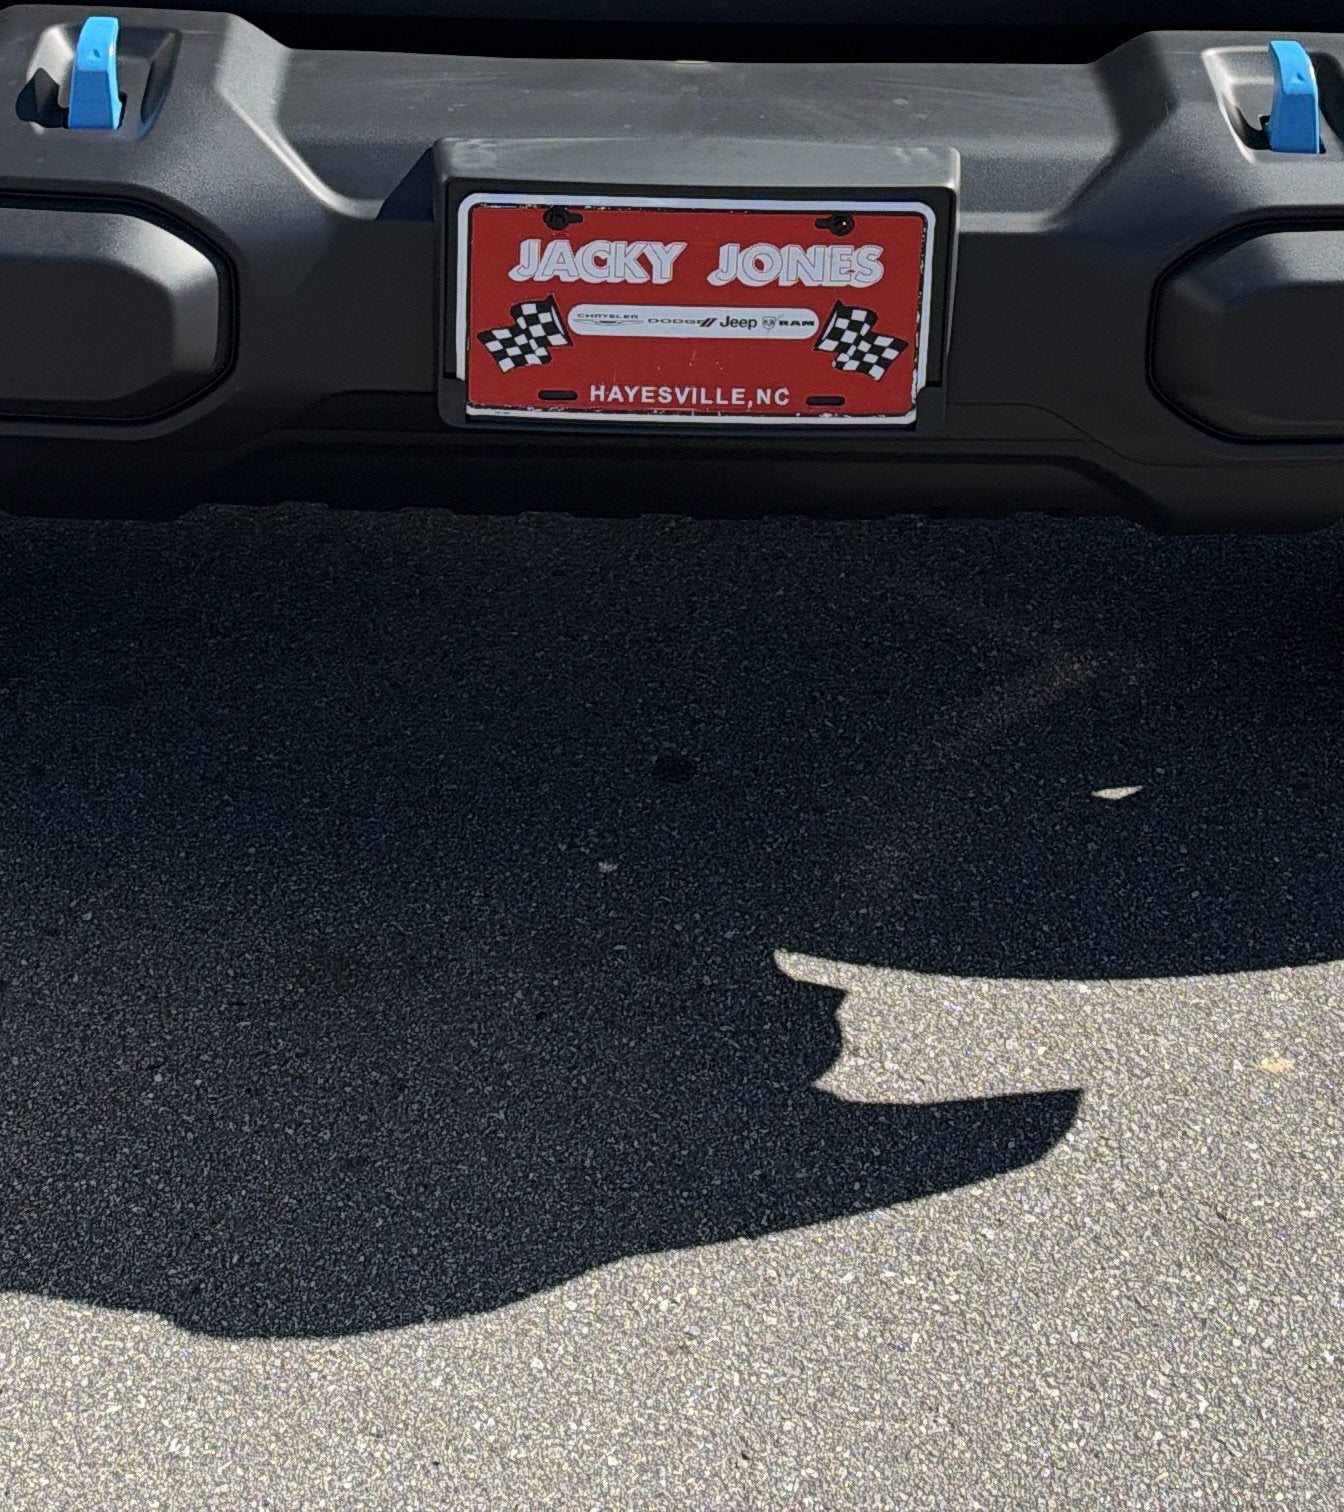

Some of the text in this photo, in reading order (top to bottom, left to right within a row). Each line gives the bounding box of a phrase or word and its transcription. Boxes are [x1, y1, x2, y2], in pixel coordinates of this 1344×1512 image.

[508, 239, 885, 287] JACKY JONES
[576, 312, 639, 320] CHRYSLER
[719, 315, 758, 330] Jeep
[590, 384, 790, 409] HAYESVILLE,NC
